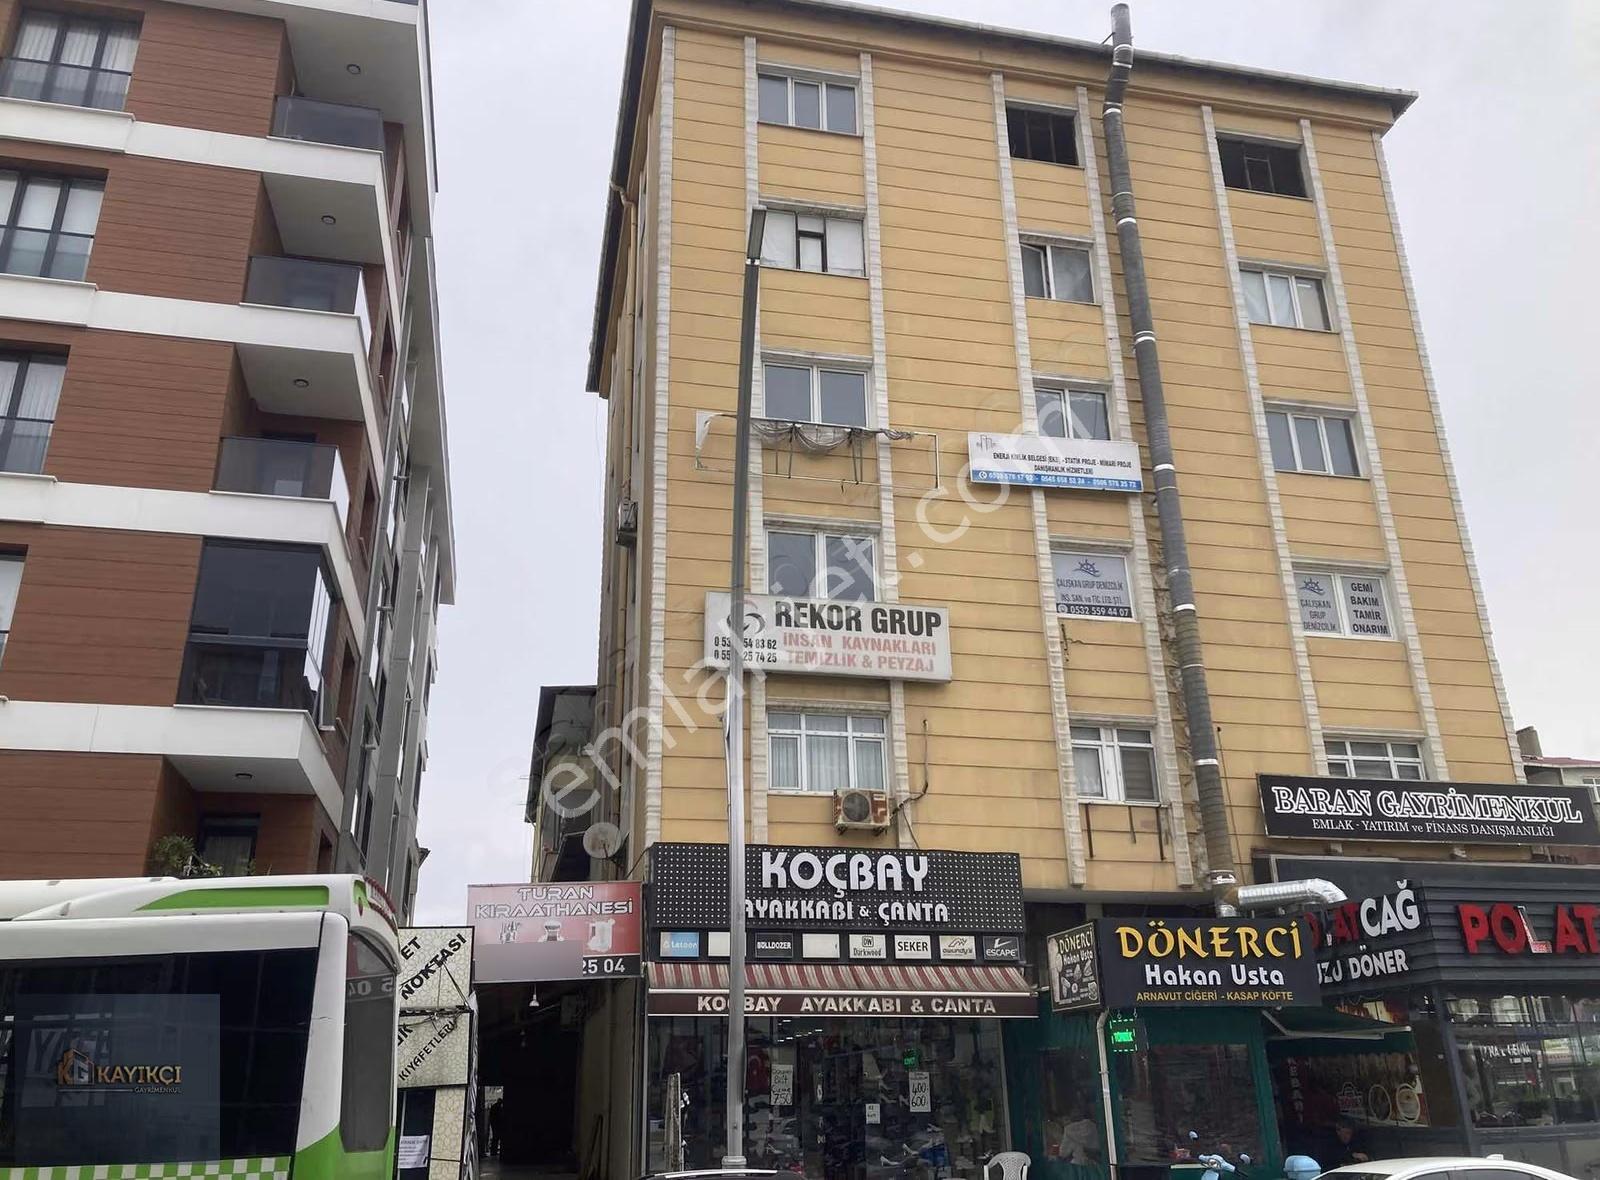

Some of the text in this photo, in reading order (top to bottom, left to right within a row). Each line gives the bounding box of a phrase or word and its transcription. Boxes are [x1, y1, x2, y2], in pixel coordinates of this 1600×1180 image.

[1350, 582, 1373, 593] GEMİ
[1350, 595, 1379, 606] BAKIM
[775, 601, 941, 637] REKOR GRUP
[1070, 605, 1128, 617] 0532 559 44 07
[1353, 609, 1381, 620] TAMİR
[1352, 623, 1388, 634] ONARIM
[767, 639, 777, 650] 62
[842, 635, 937, 656] KAYNAKLARI
[767, 653, 777, 664] 25
[862, 654, 872, 669] &
[878, 655, 934, 673] PEYZAJ
[1271, 786, 1584, 824] BARAN GAYRİMENKUL
[1312, 818, 1354, 831] EMLAK
[1362, 819, 1409, 833] YATIRIM
[1411, 824, 1424, 833] ve
[1426, 820, 1469, 835] FİNANS
[1470, 822, 1554, 838] DANIŞMANLIĞI
[761, 851, 929, 898] KOÇBAY
[518, 885, 593, 900] TURAN
[475, 898, 633, 919] KIRAATHANESİ
[859, 904, 870, 918] &
[877, 901, 949, 926] ÇANTA
[1360, 878, 1421, 939] CAĞ
[400, 936, 422, 961] ET
[897, 940, 929, 953] SEKER
[1059, 928, 1094, 954] DÖNERCİ
[1115, 920, 1303, 960] DÖNERCİ
[1080, 949, 1093, 962] Usta
[1349, 944, 1409, 981] DÖNER
[400, 932, 467, 1000] NOKTASI
[604, 958, 625, 973] 04
[1145, 964, 1285, 986] Hakan Usta
[697, 995, 782, 1012] KOBAY
[800, 996, 901, 1014] AYAKKABI
[910, 998, 924, 1014] &
[1136, 991, 1181, 1001] ARNAVUT
[1185, 989, 1218, 1001] CİĞERİ
[1226, 991, 1260, 1001] KASAP
[1262, 990, 1294, 1001] KÖFTE
